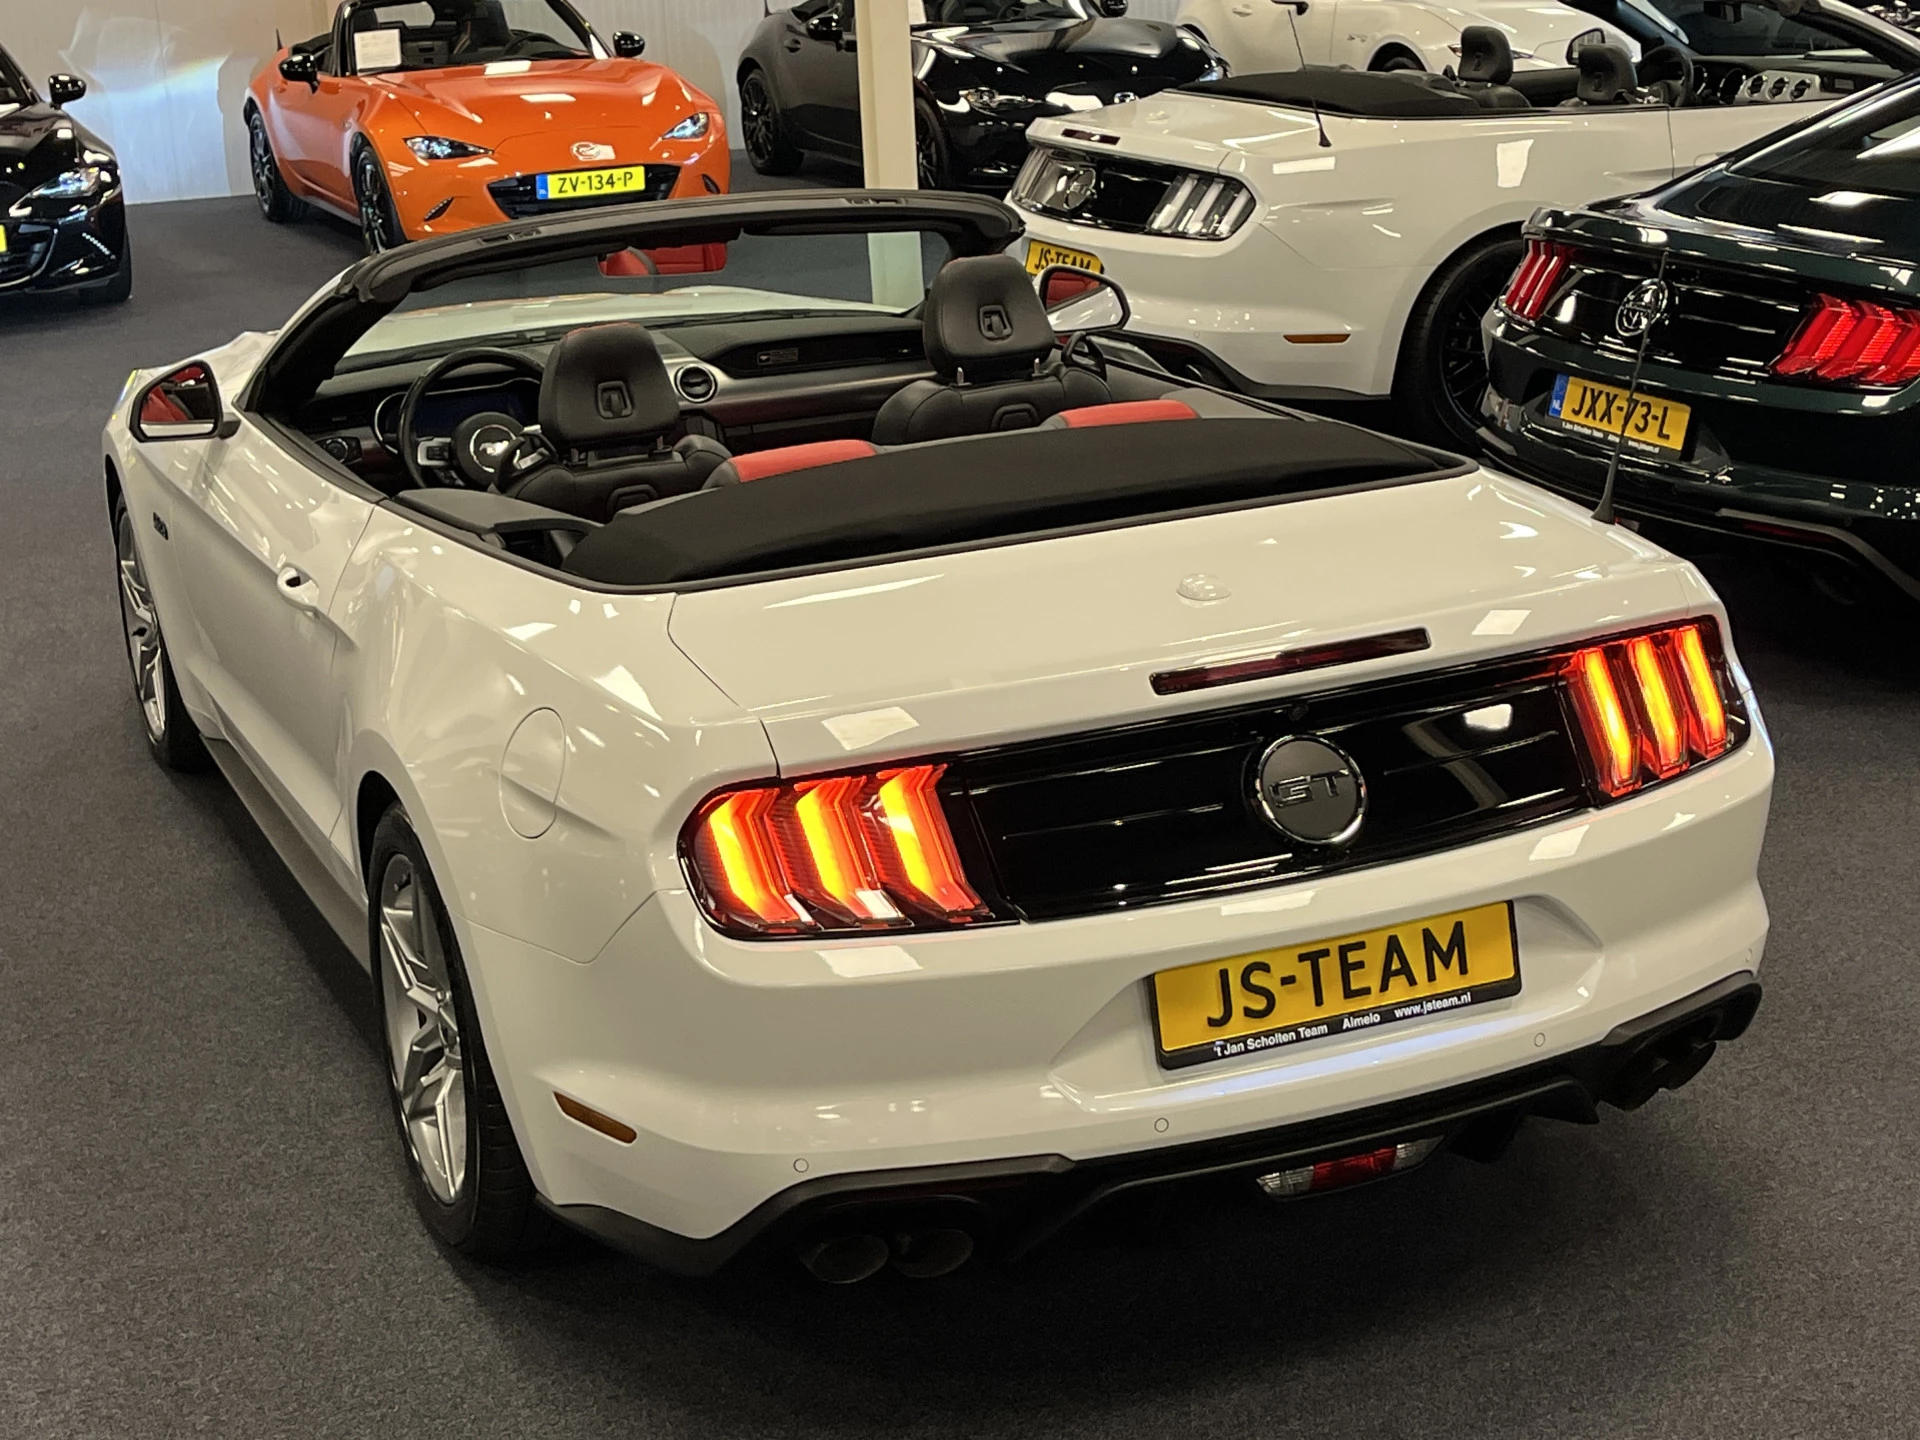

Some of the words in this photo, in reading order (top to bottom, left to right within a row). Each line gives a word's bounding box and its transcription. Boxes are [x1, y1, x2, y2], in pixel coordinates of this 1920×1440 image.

[557, 171, 633, 194] ZV-134-P
[1571, 385, 1671, 441] JXX-73-L
[1269, 768, 1350, 808] GT
[1206, 920, 1469, 1028] JS-TEAM
[1224, 1042, 1245, 1056] Jan
[1246, 1032, 1297, 1050] Scholten
[1299, 1023, 1328, 1039] Team
[1342, 1012, 1381, 1030] Almelo
[1394, 991, 1472, 1018] www.jsteam.nl
